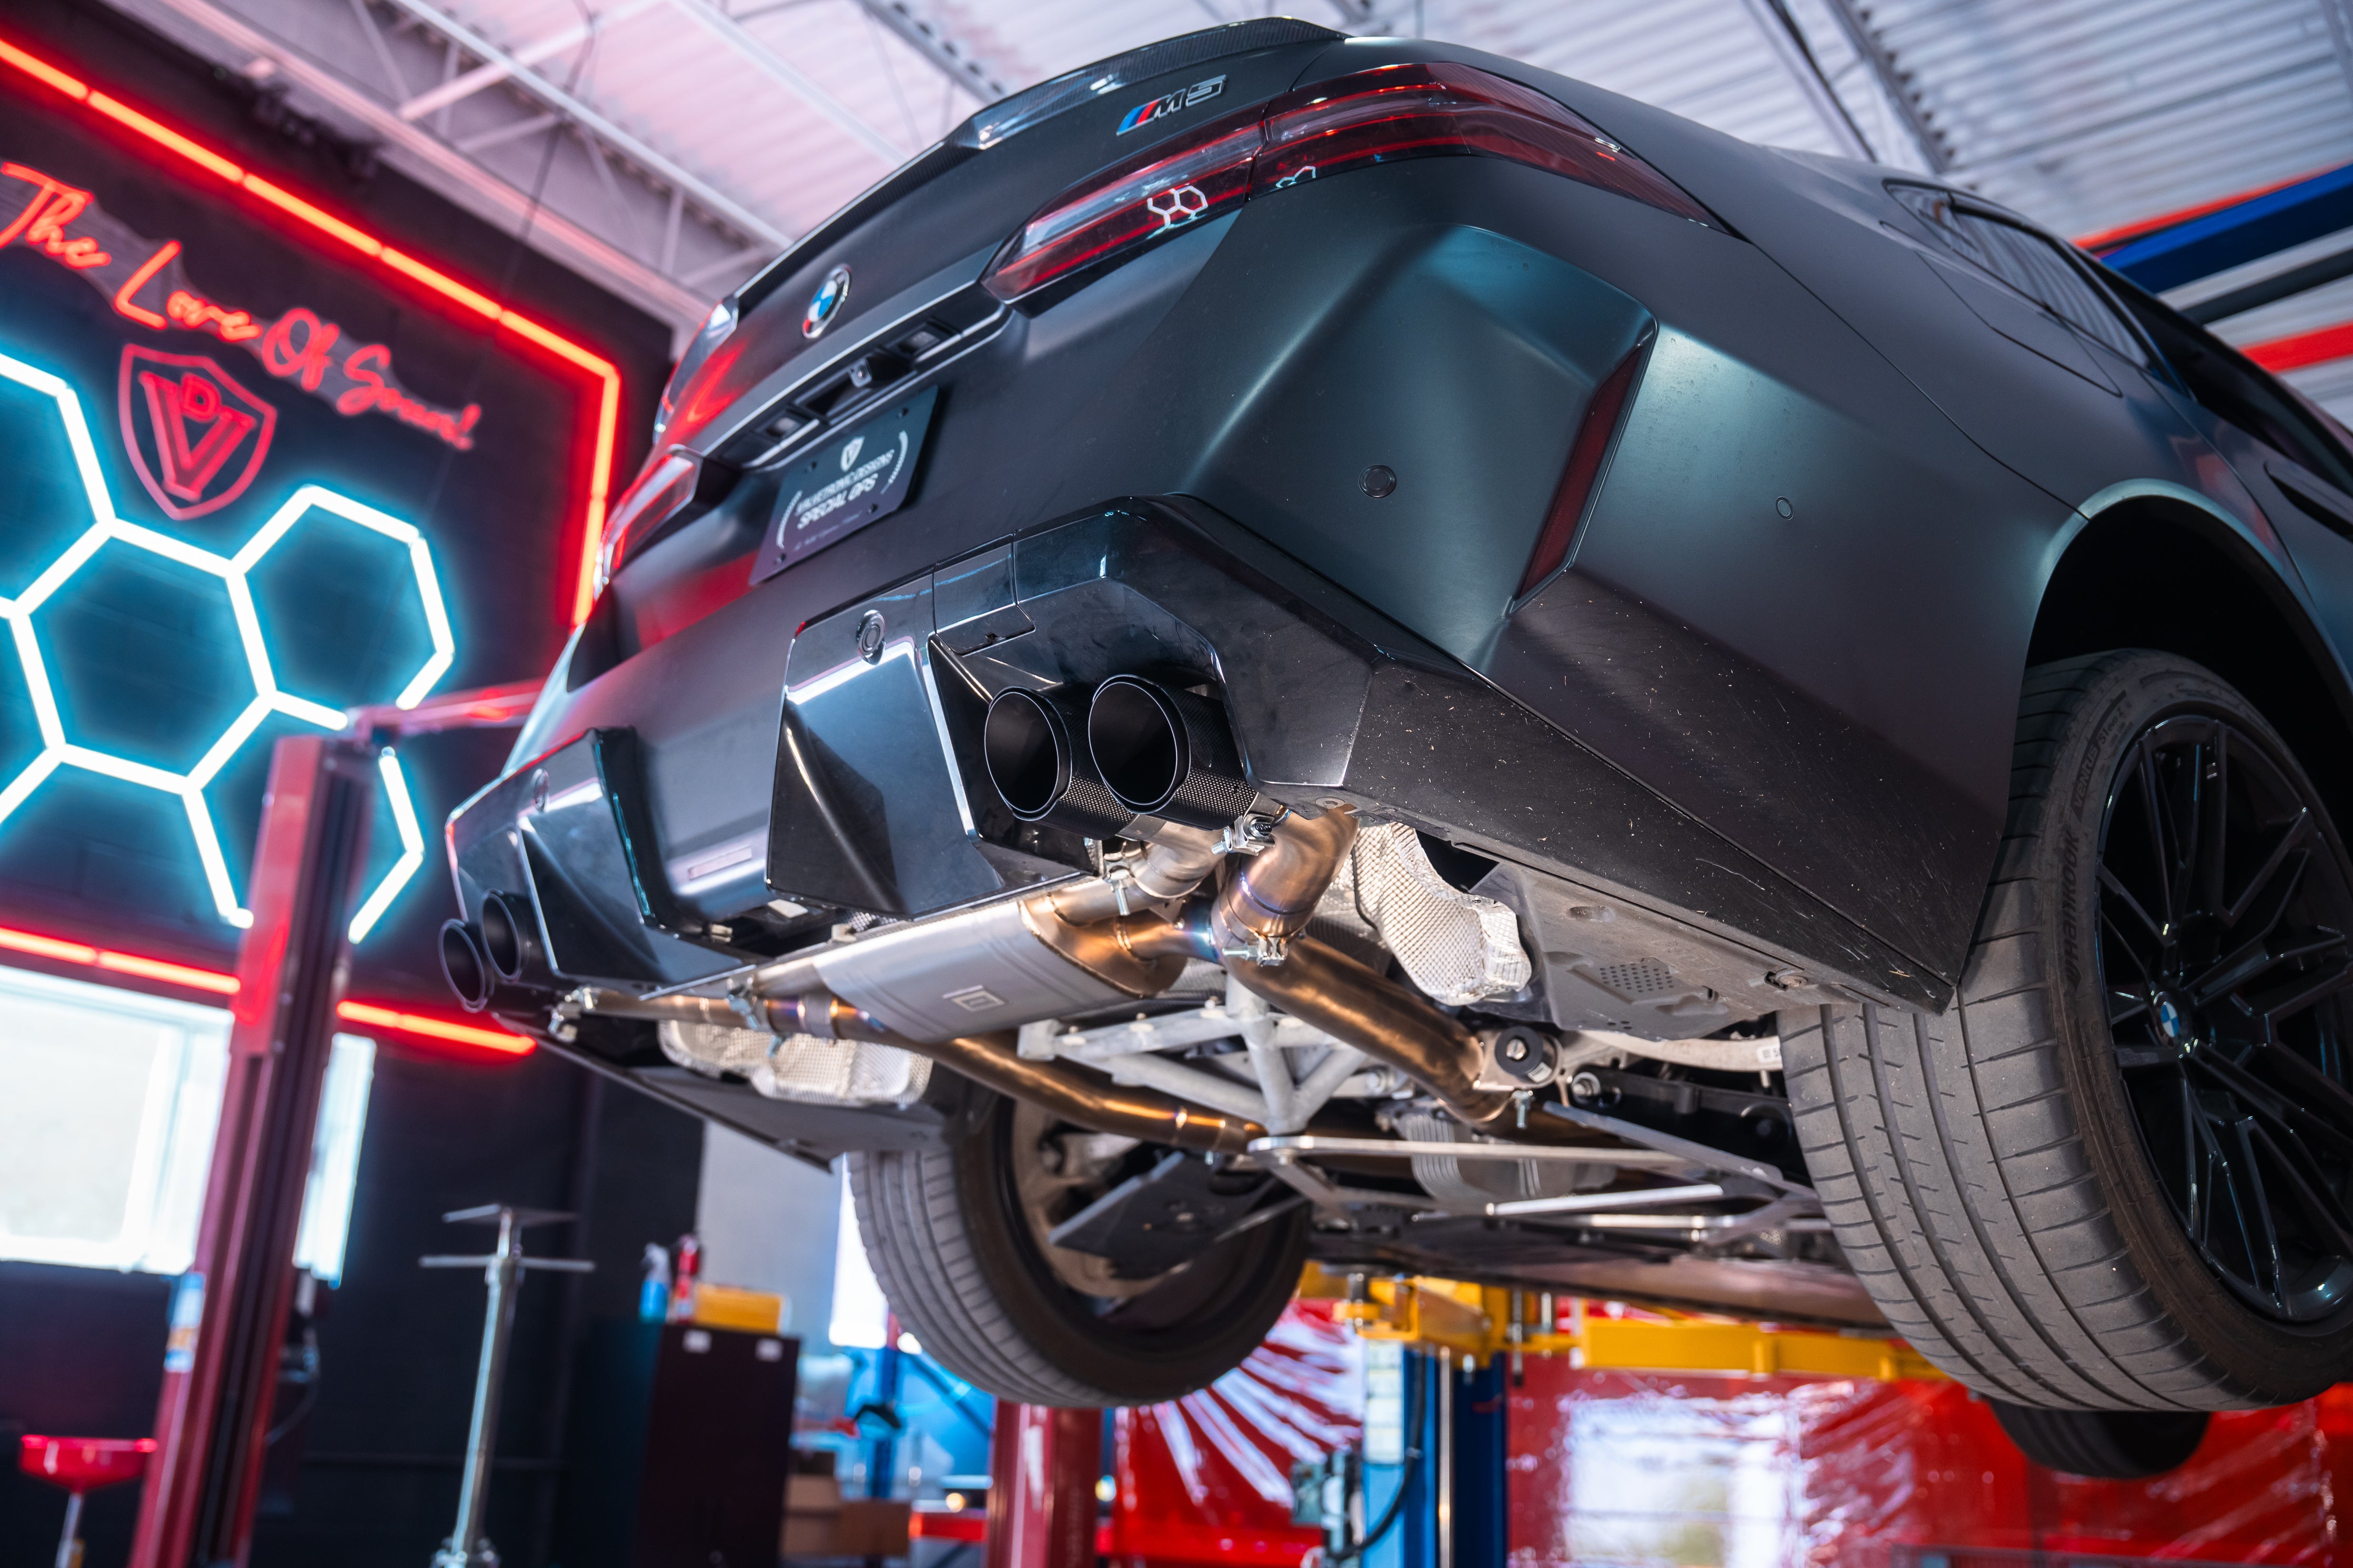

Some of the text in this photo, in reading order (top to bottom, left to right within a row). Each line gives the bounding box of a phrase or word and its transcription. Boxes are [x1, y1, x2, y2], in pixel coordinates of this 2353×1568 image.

[1138, 74, 1228, 127] M5
[0, 161, 112, 270] The
[262, 308, 340, 392] Of
